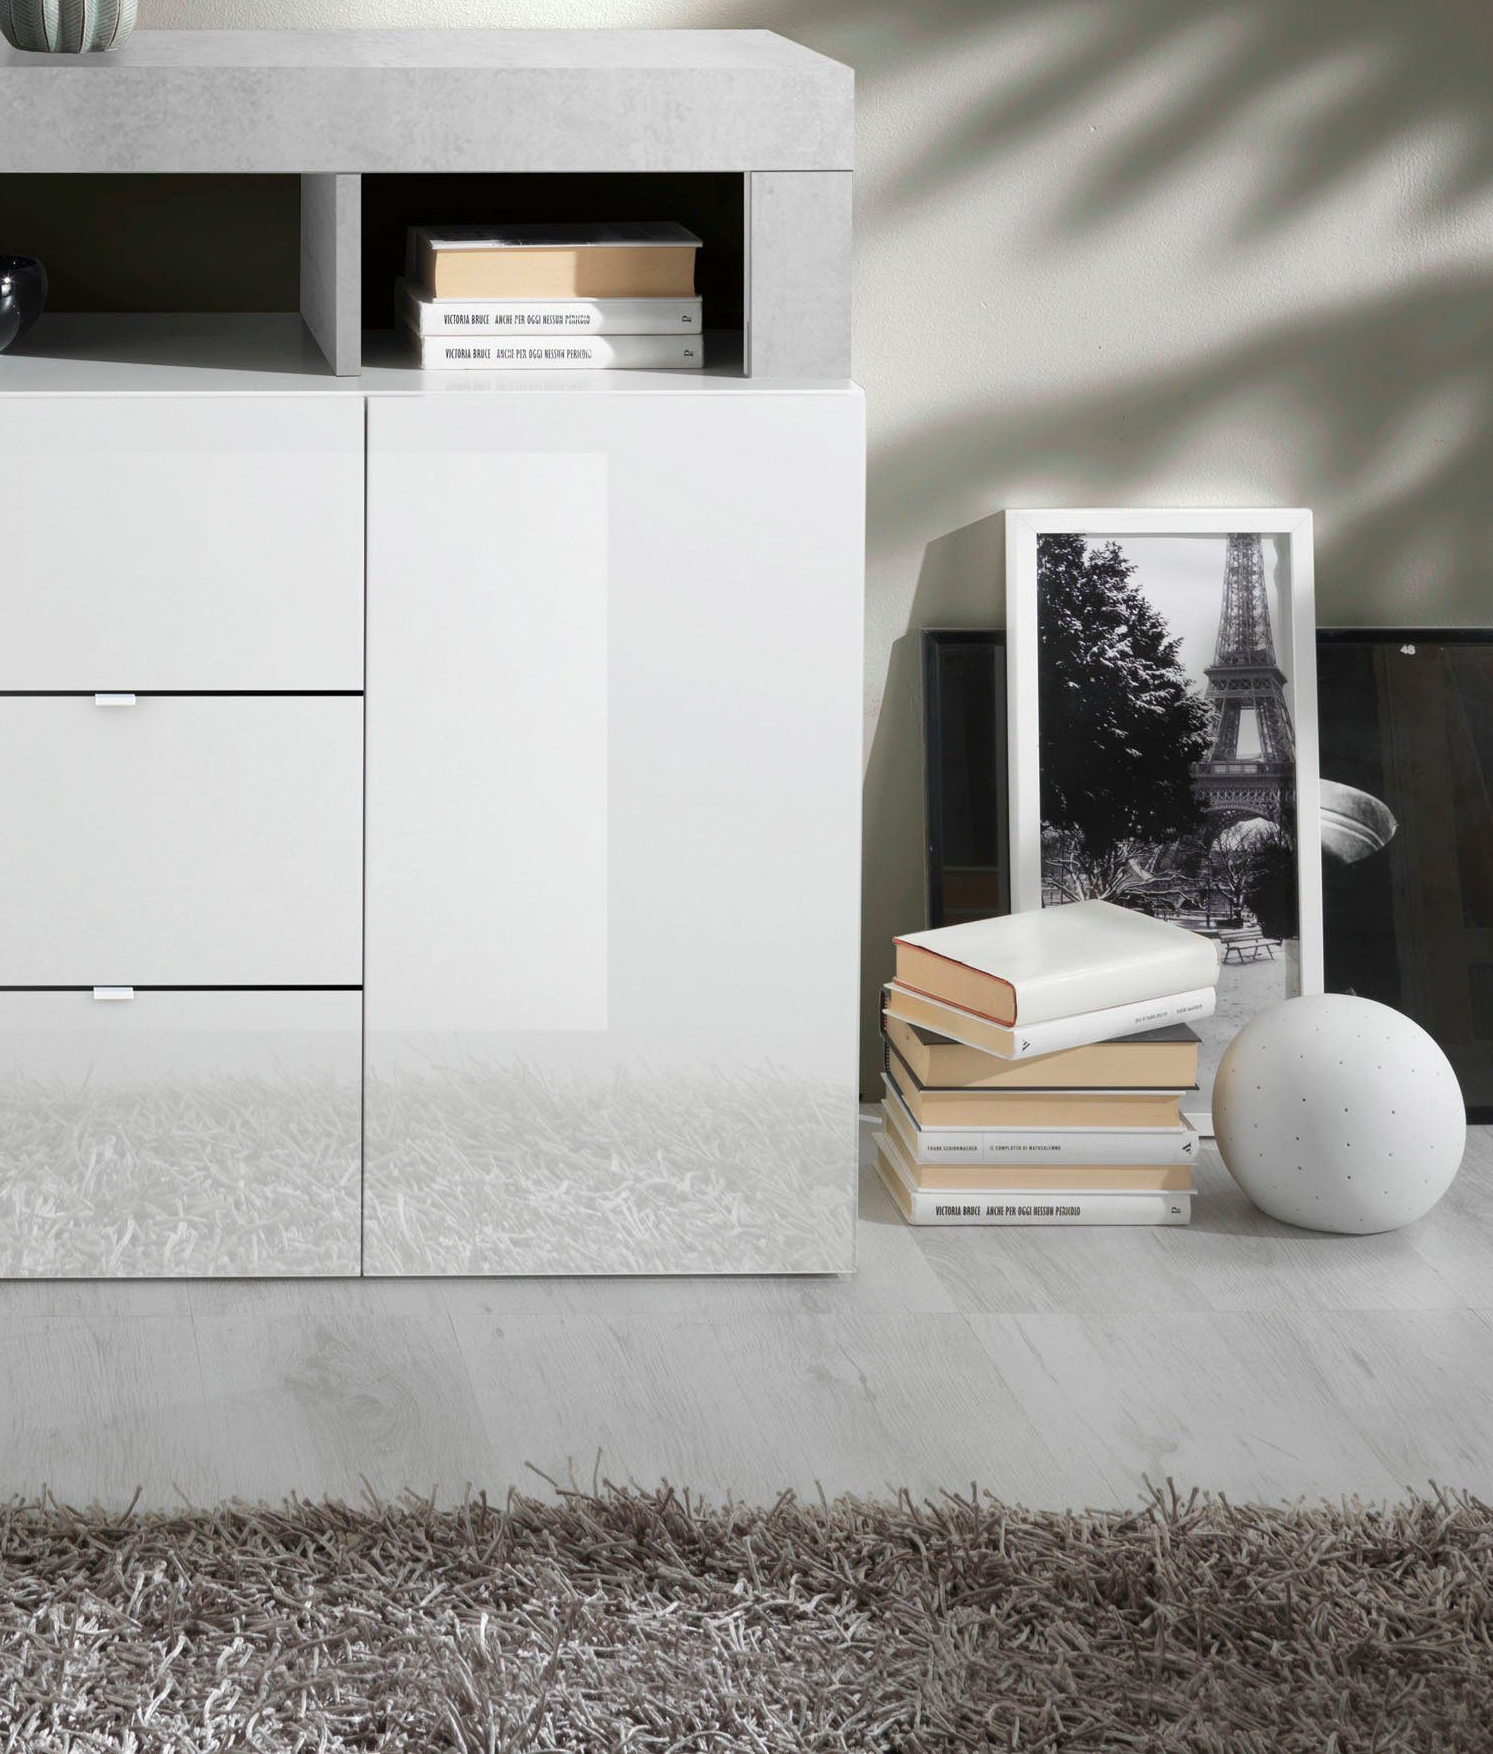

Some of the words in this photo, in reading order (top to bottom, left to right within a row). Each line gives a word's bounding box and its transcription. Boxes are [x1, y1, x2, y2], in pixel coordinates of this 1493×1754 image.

[444, 314, 470, 325] VICTORIA
[471, 314, 490, 325] BRUCE
[527, 314, 541, 325] OGGI
[445, 348, 471, 359] VICTORIA
[473, 348, 491, 359] BRUCE
[528, 348, 543, 359] OGGI
[935, 1206, 961, 1216] VICTORIA
[963, 1206, 981, 1216] BRUCE
[986, 1206, 1004, 1216] ANCHE
[1005, 1206, 1017, 1216] PER
[1018, 1206, 1032, 1216] OGGI
[1033, 1206, 1054, 1216] NESSUN
